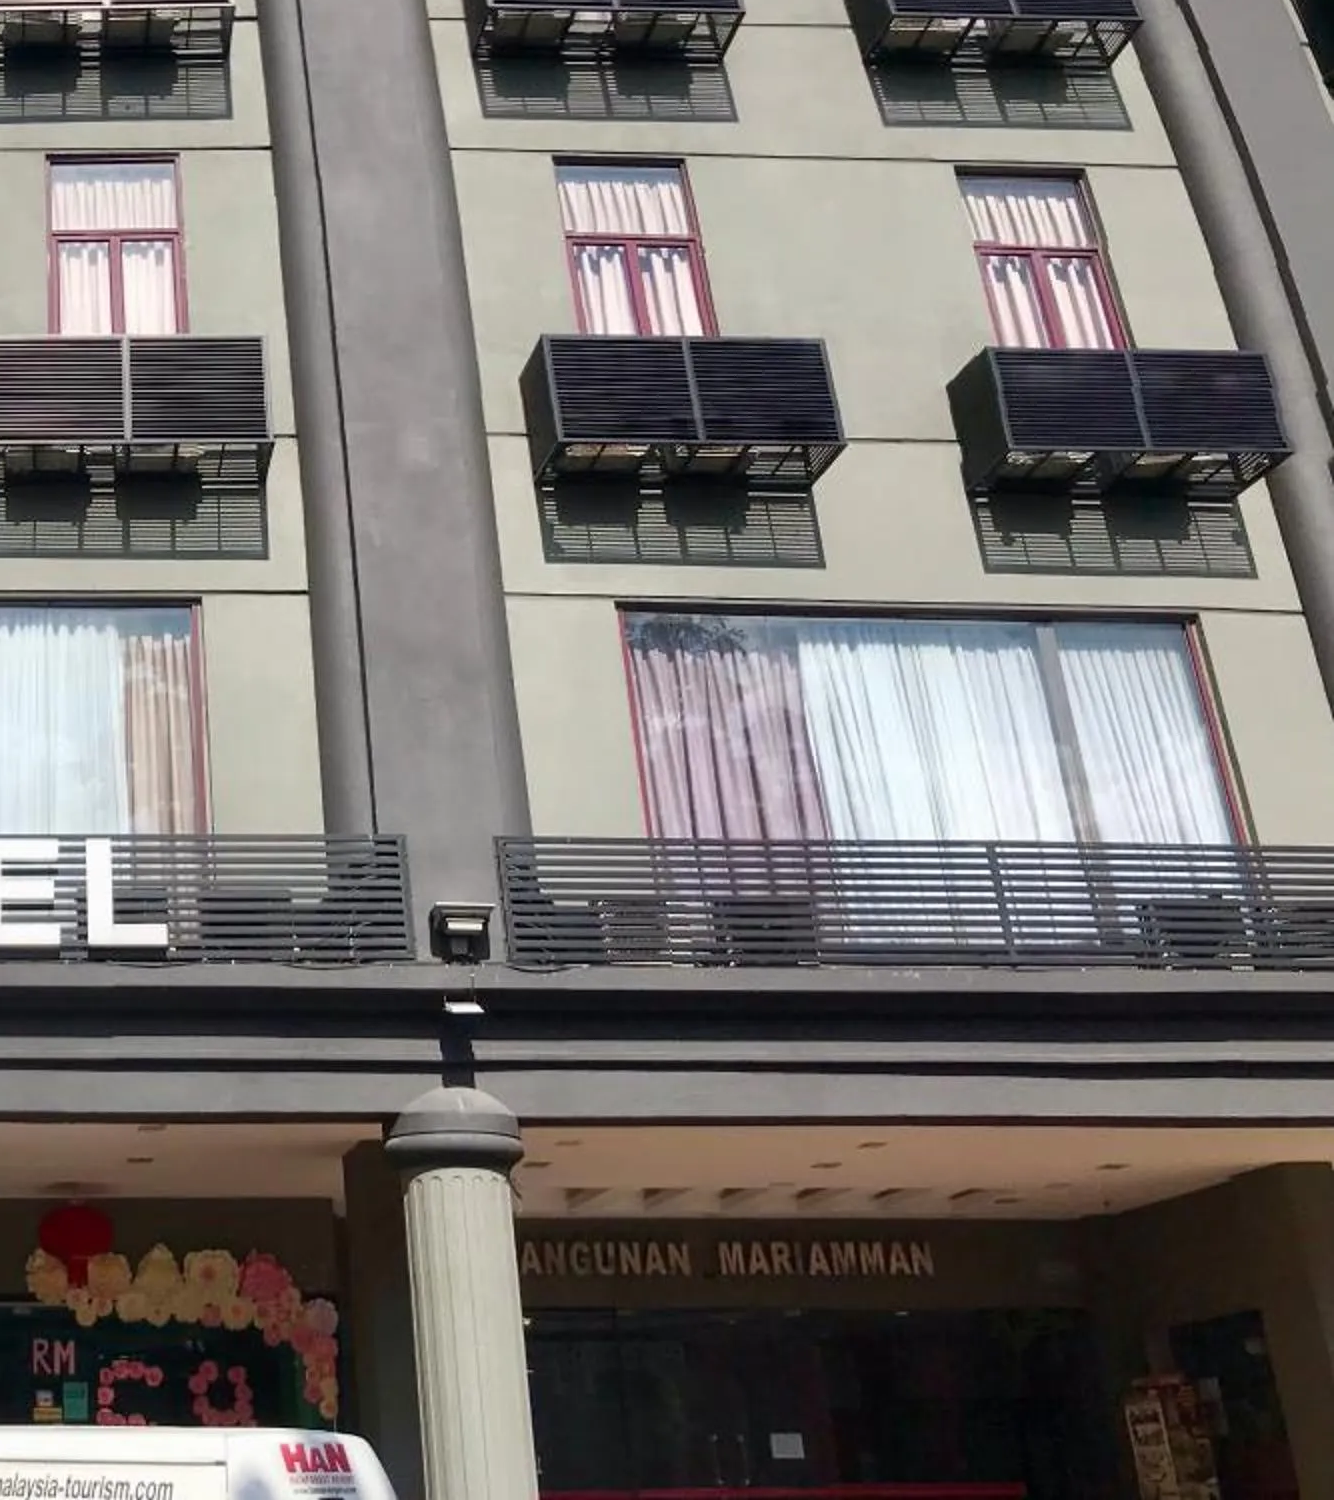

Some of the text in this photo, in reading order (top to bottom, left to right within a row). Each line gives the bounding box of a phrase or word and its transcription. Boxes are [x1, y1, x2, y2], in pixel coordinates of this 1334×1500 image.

[519, 1238, 937, 1280] ANGUNAN MARIAMMAN
[32, 1337, 76, 1376] RM
